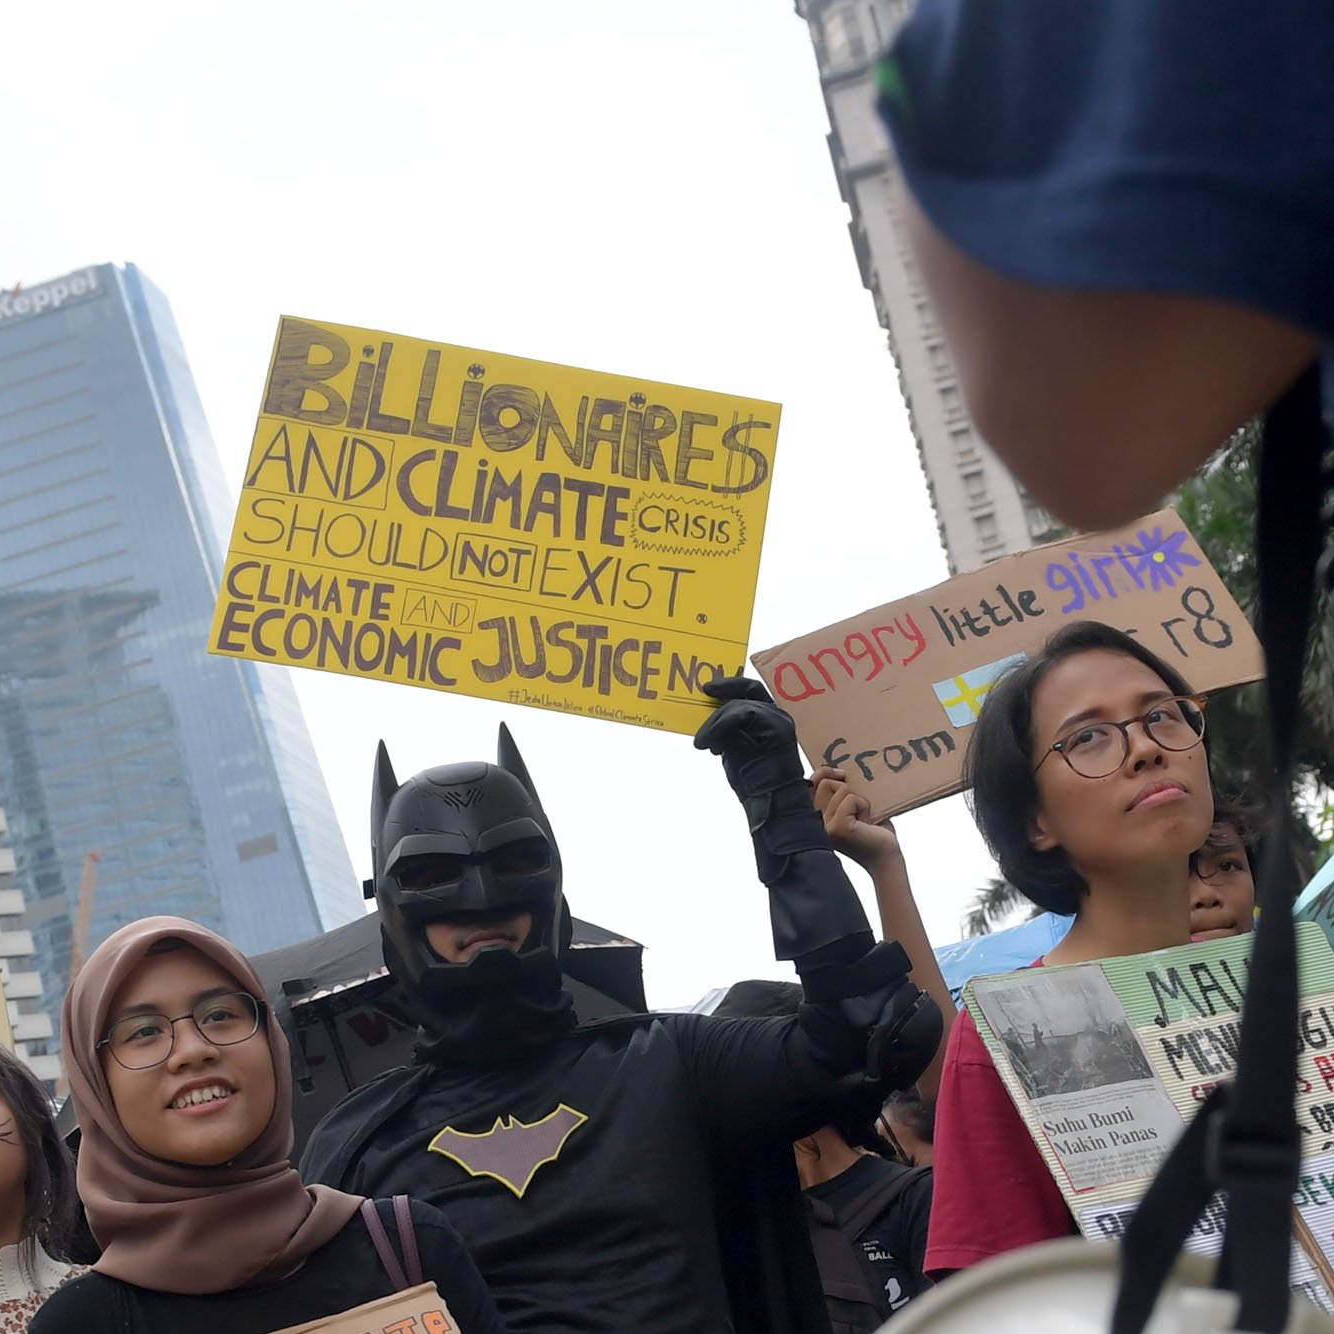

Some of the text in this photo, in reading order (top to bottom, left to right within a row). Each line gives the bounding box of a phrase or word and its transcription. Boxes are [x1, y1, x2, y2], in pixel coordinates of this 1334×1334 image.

[246, 423, 387, 502] AND
[637, 504, 732, 546] CRISIS
[226, 560, 471, 628] CLIMATE AND
[243, 497, 708, 626] SHOULD NOT EXIST.
[216, 602, 462, 687] ECONOMIC
[471, 615, 663, 700] JUSTICE
[773, 612, 927, 702] angry
[929, 585, 1045, 648] little
[821, 729, 957, 782] from
[1043, 1105, 1136, 1138] Suhu Bumi
[1052, 1126, 1159, 1158] Makin Panas
